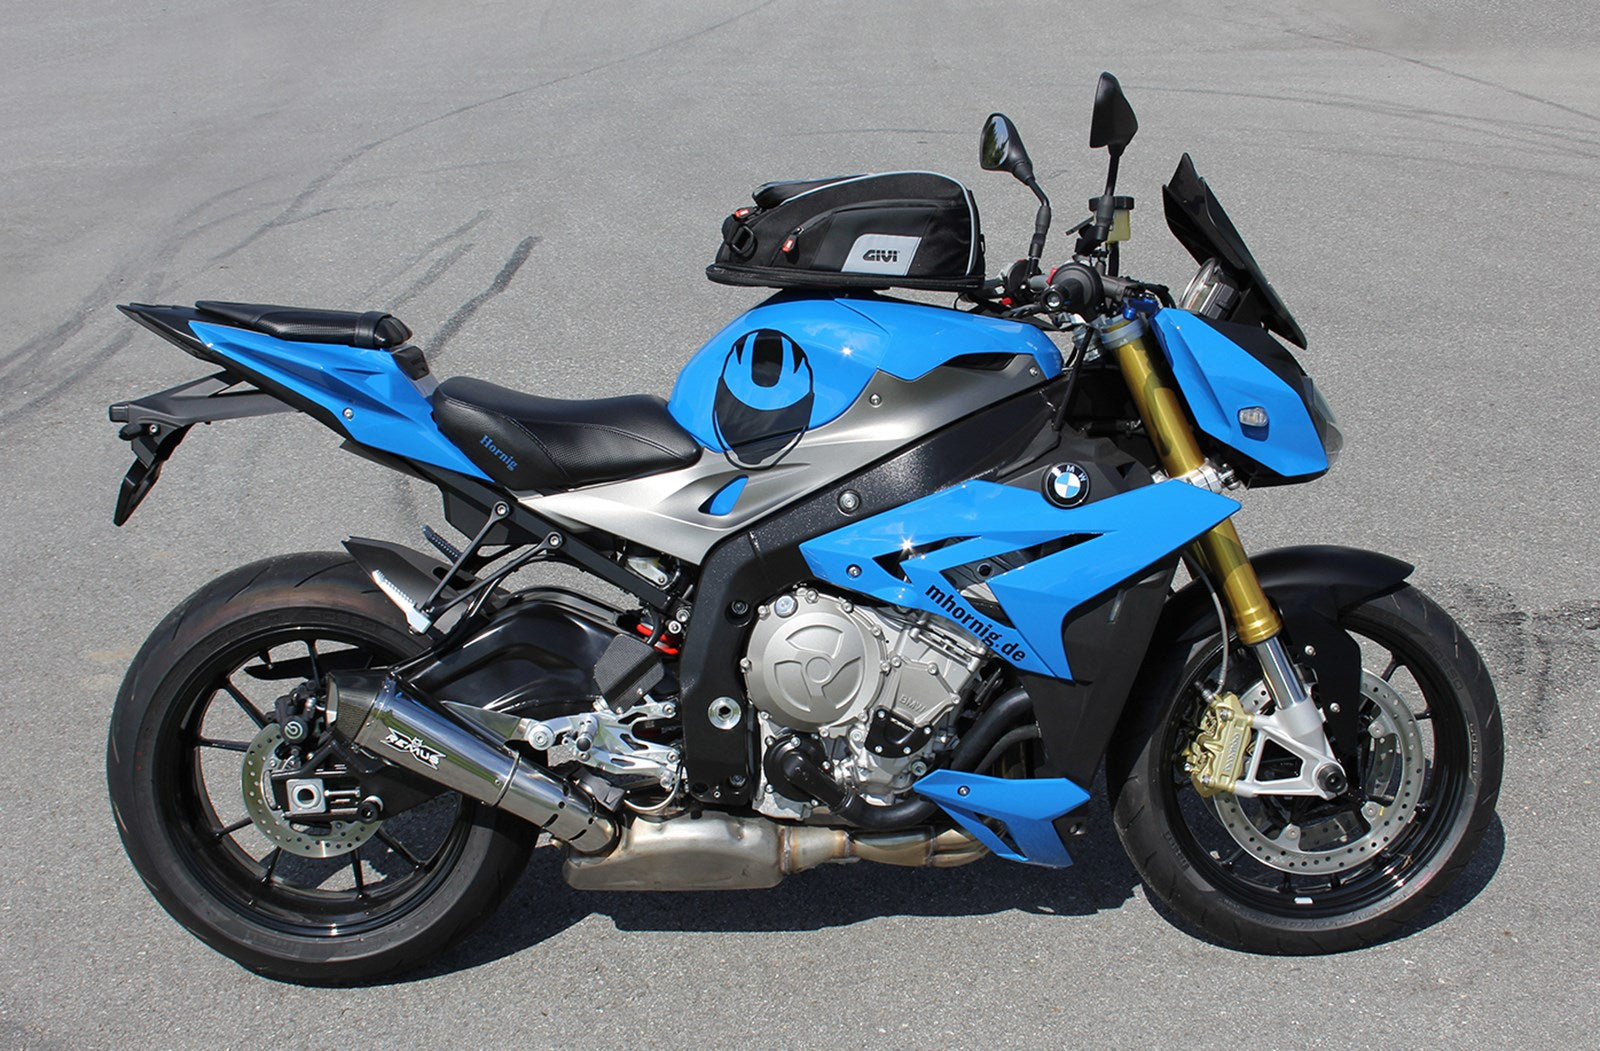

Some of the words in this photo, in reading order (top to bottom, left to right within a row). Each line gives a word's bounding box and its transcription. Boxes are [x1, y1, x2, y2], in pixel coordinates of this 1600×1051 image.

[863, 249, 898, 263] GIVI
[480, 434, 518, 471] Hornig
[925, 584, 1026, 662] mhornig.de
[900, 694, 927, 713] BMW
[385, 733, 440, 765] REMUS
